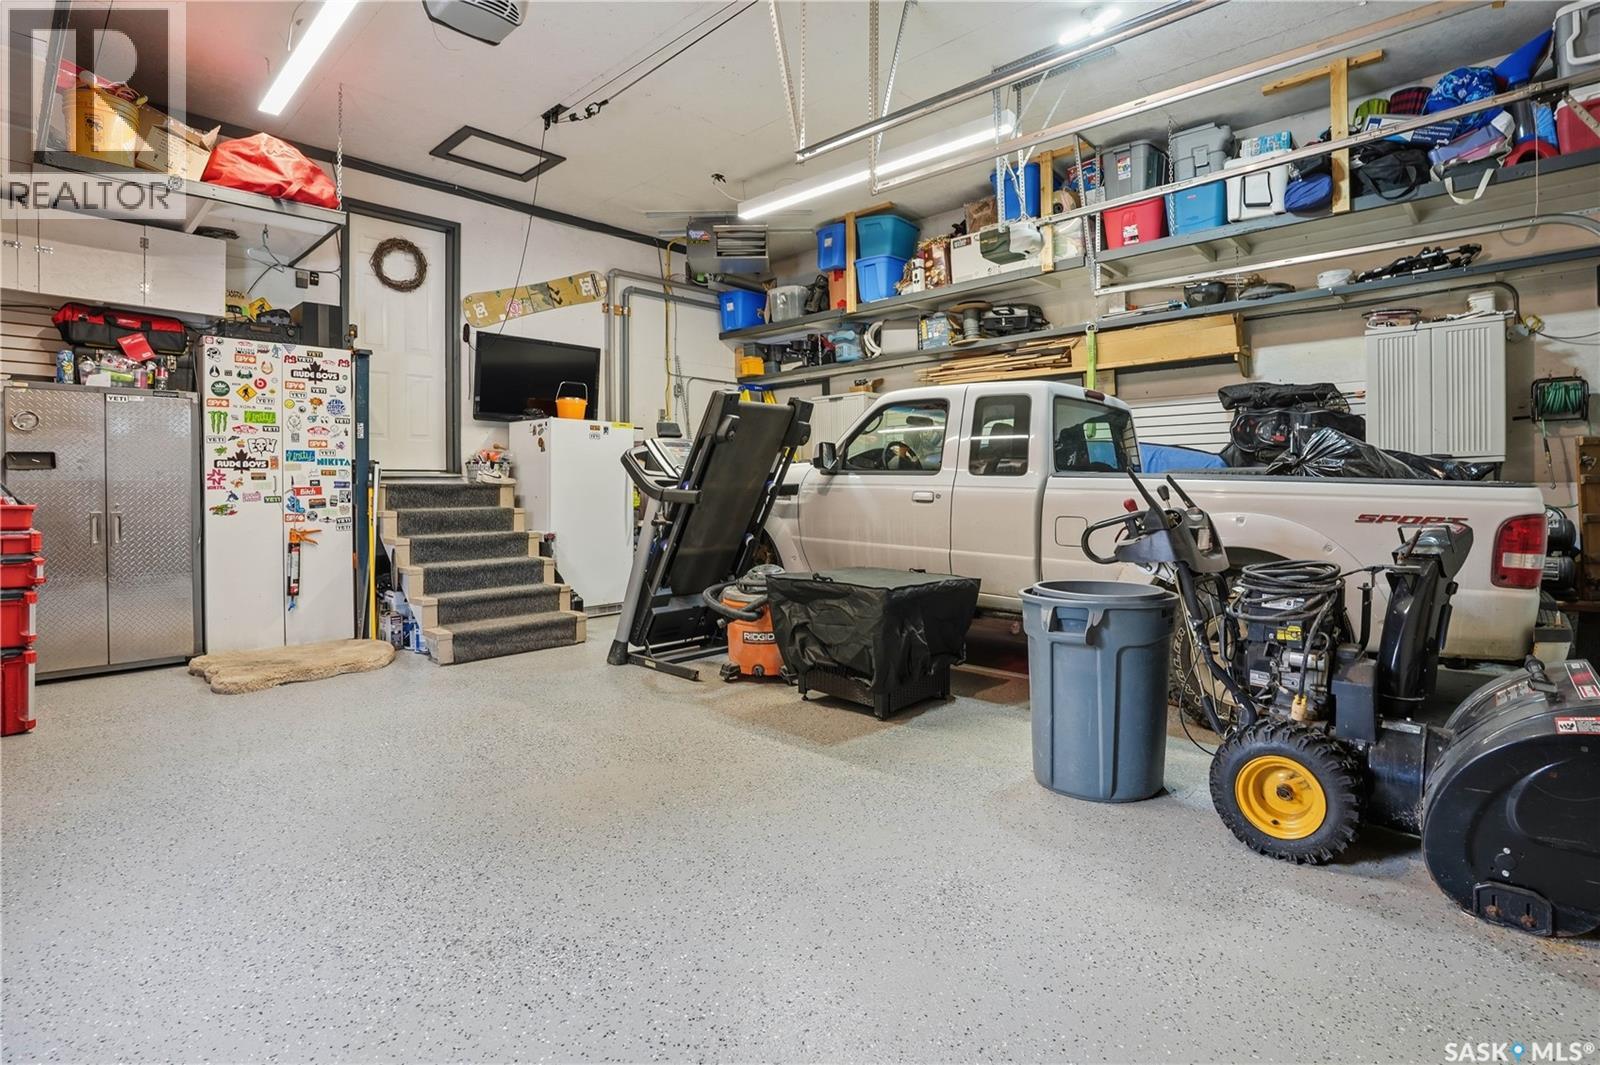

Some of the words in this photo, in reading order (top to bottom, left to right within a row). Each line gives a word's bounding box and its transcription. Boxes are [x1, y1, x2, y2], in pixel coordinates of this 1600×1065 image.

[293, 370, 315, 378] RUDE
[316, 372, 338, 380] BOYS
[216, 460, 241, 468] RUDE
[242, 460, 267, 468] BOYS
[317, 458, 350, 466] NIKITA
[1355, 514, 1469, 525] SPORT
